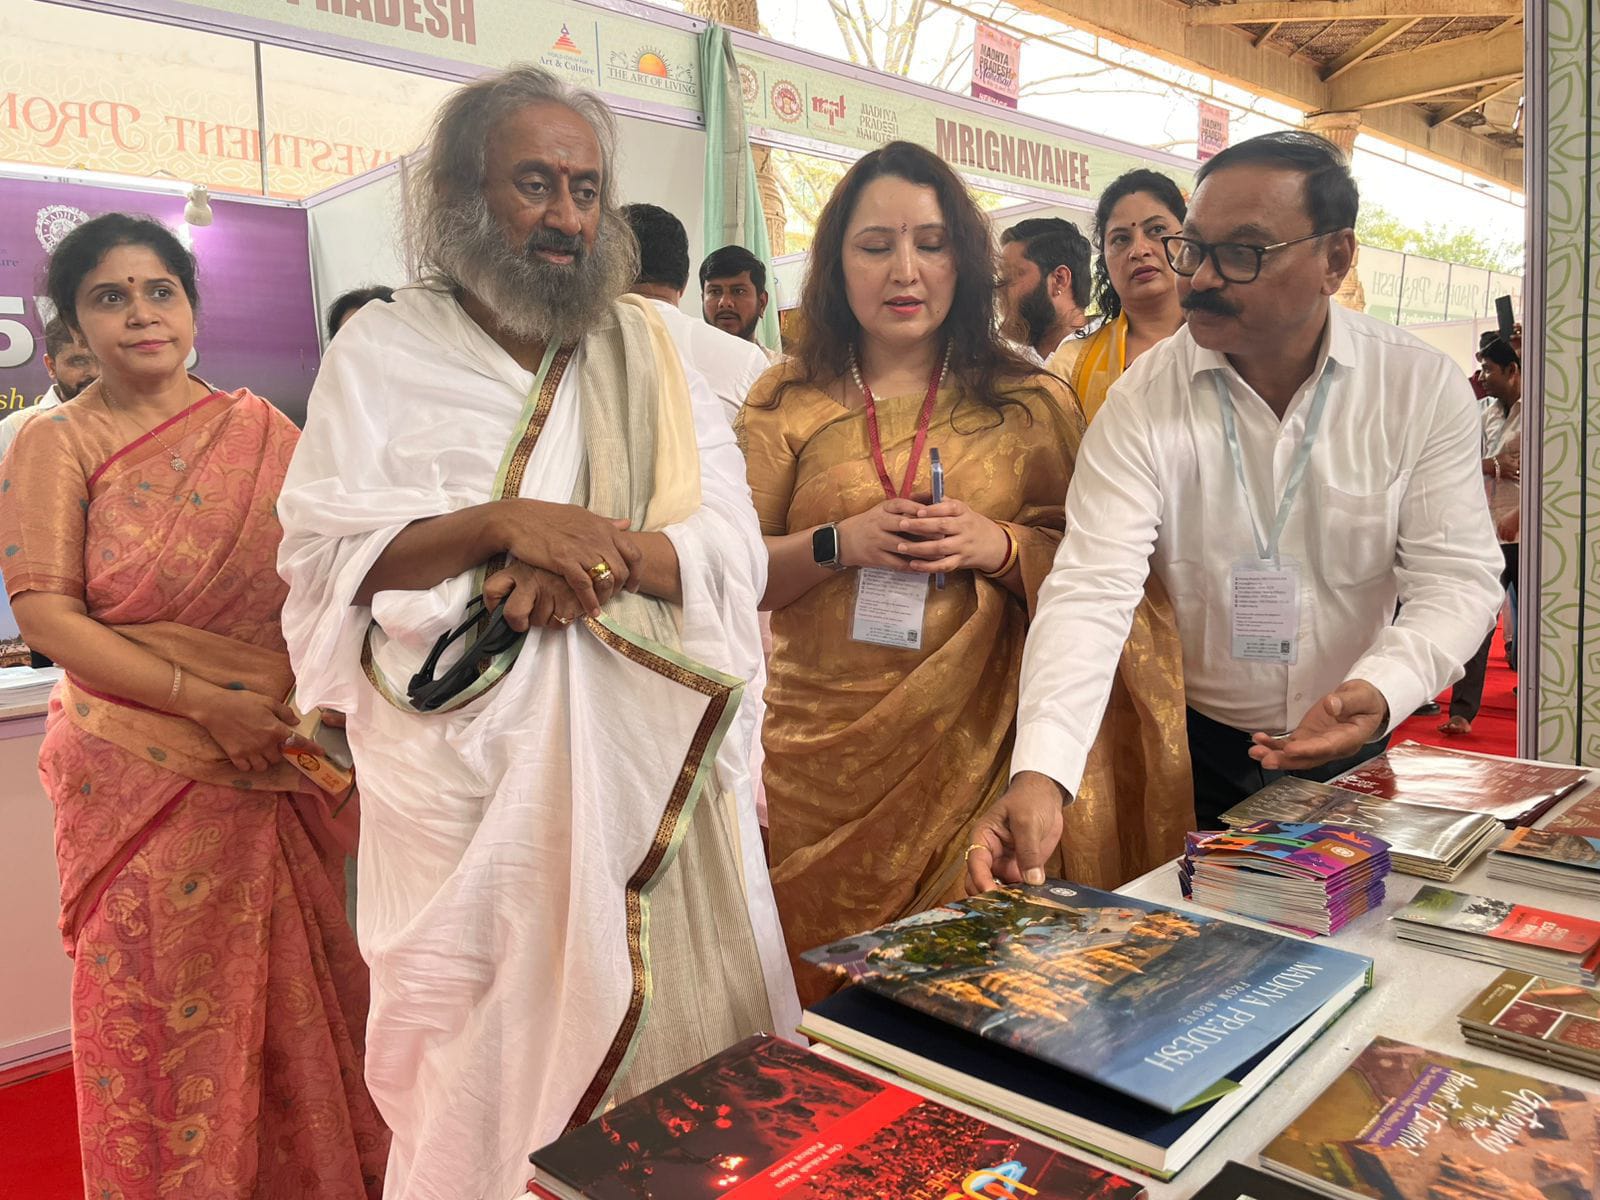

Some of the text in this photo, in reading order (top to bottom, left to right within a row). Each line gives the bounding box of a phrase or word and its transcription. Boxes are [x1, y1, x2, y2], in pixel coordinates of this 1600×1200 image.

[539, 56, 595, 76] Art & Culture
[979, 55, 1012, 80] PRADESH
[608, 67, 696, 95] THE ART OF LIVING
[859, 115, 899, 135] PRADESH
[860, 102, 897, 122] MADHYA
[856, 126, 897, 143] MAHOTS
[935, 117, 1091, 192] MRIGNAYANEE
[1144, 961, 1324, 1072] MADHYA PRADESH
[1178, 980, 1250, 1026] FROM ABOVE
[1433, 1069, 1479, 1109] Heart
[1413, 1101, 1448, 1120] of
[1457, 1102, 1498, 1131] to the
[1471, 1088, 1552, 1154] Gateway
